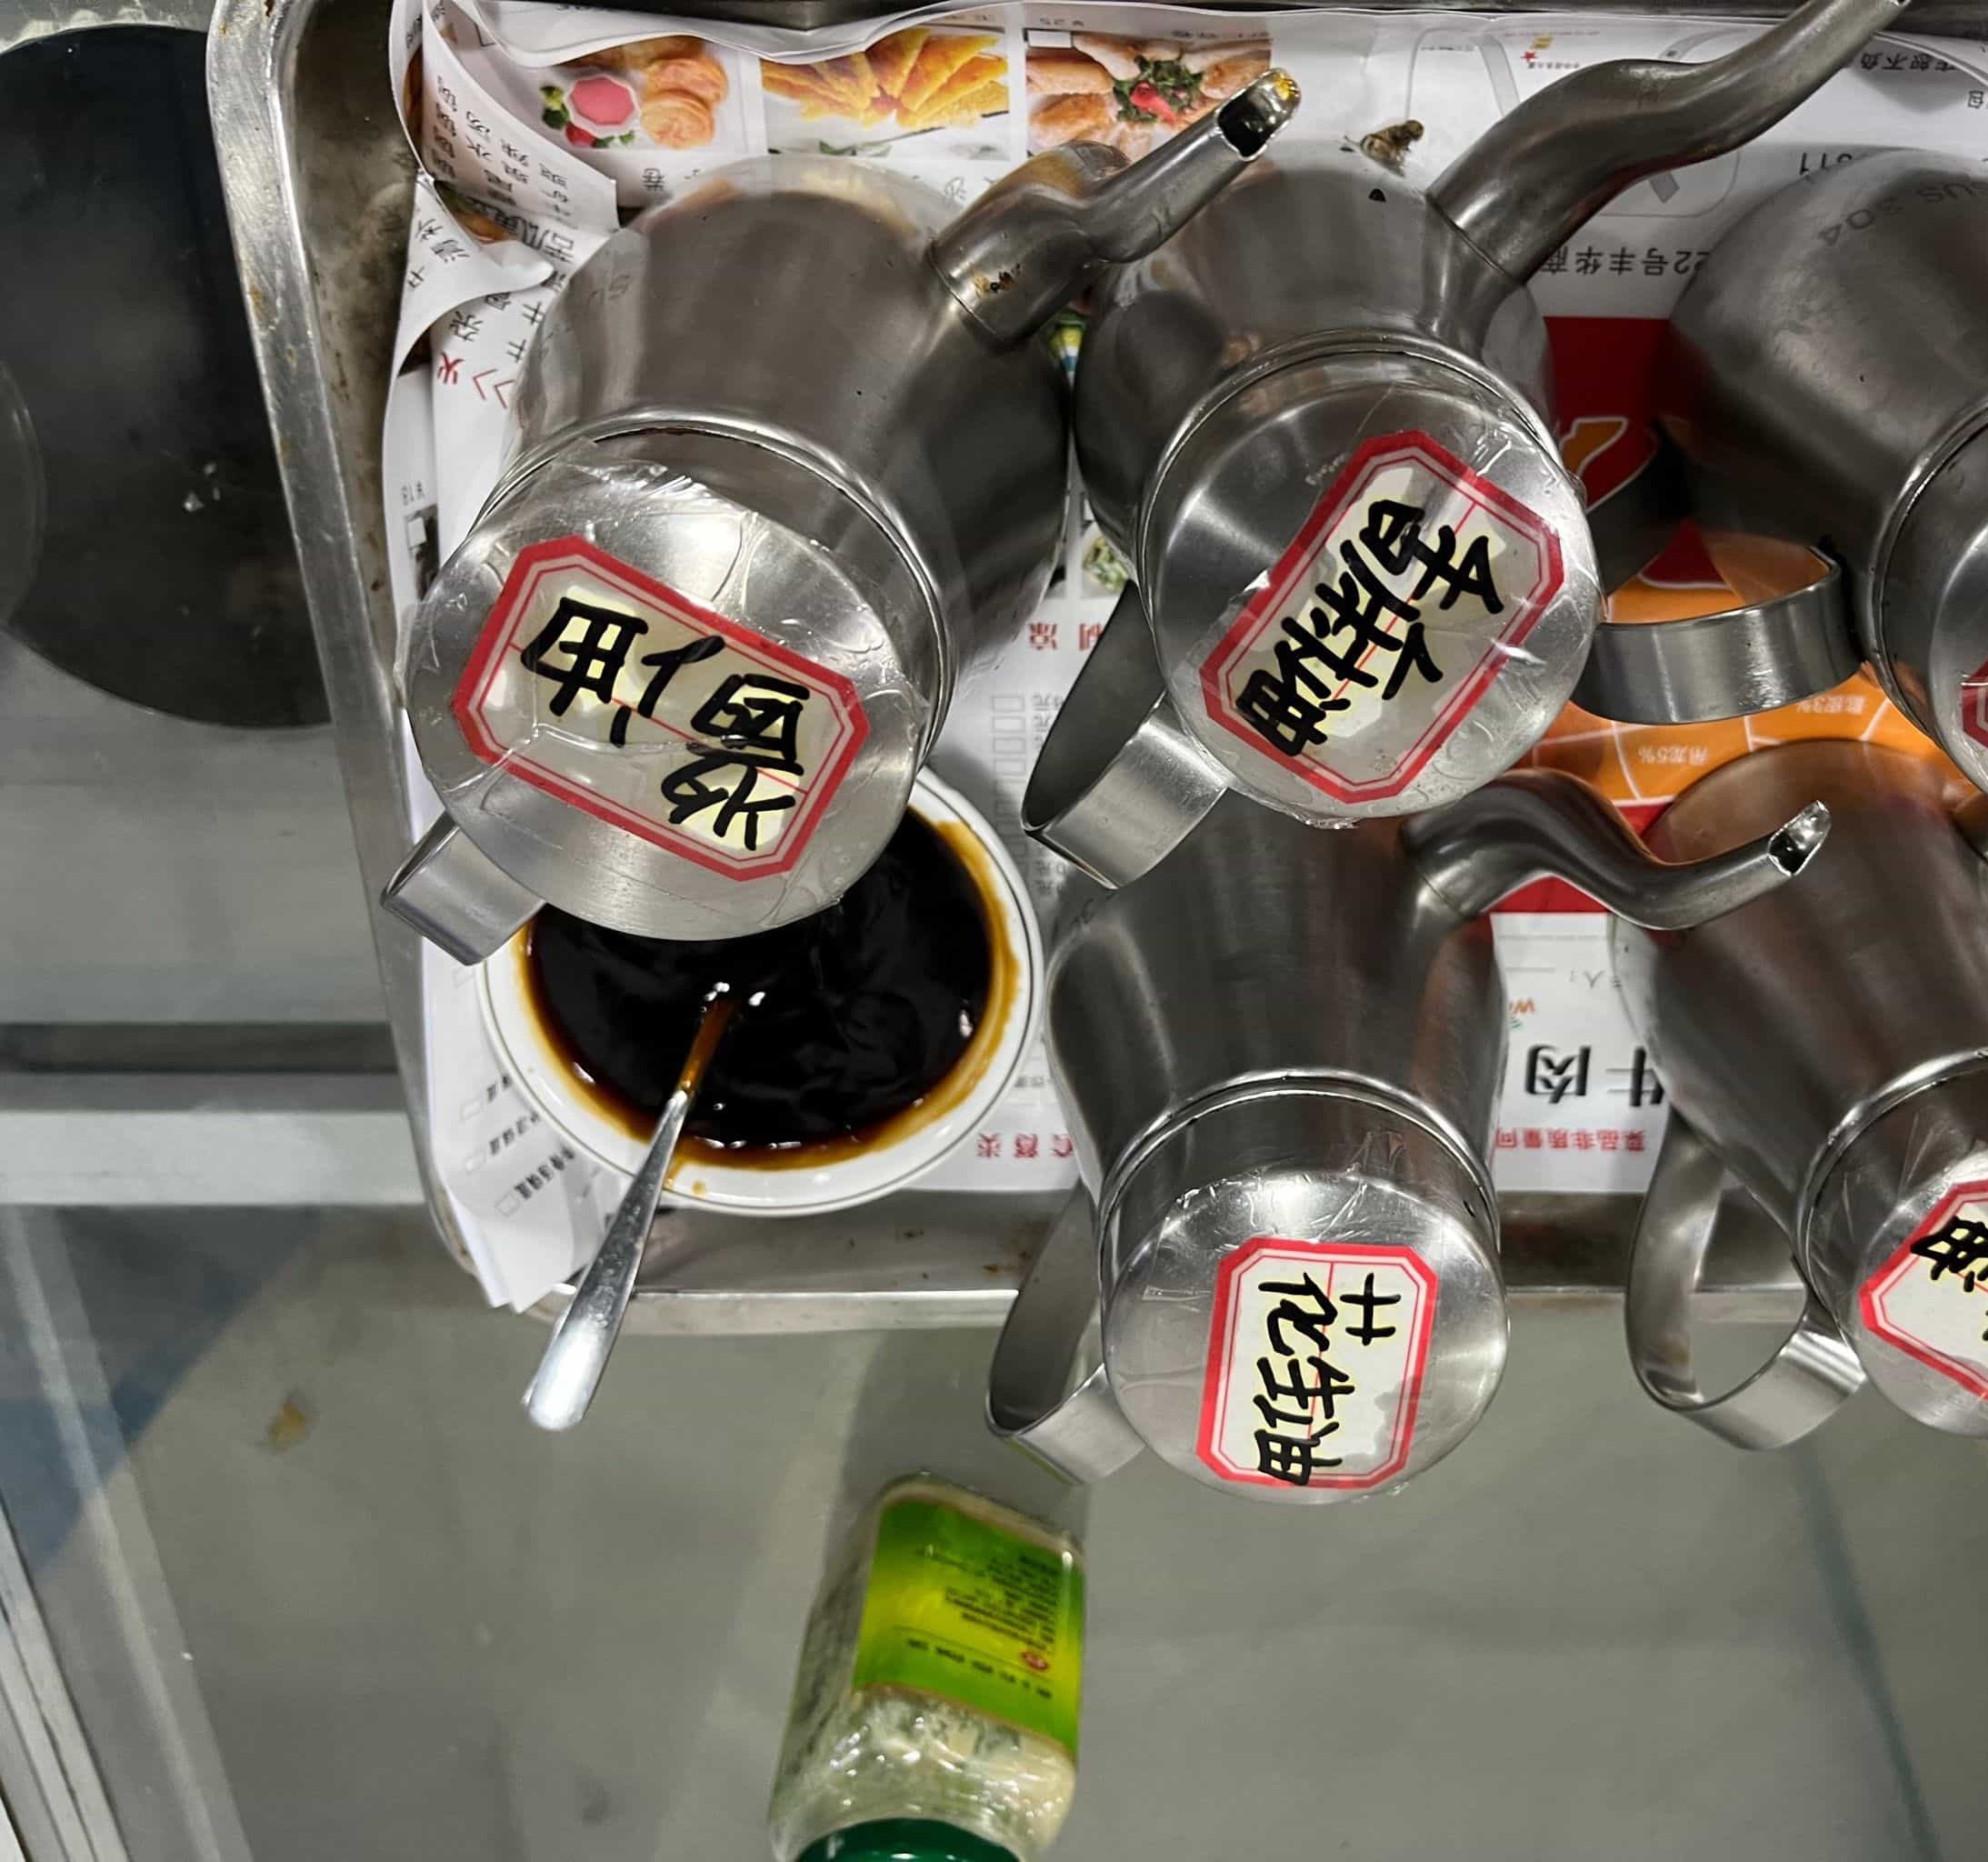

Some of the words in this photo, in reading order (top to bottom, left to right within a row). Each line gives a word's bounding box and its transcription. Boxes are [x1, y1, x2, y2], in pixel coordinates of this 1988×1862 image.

[520, 596, 810, 852] 酱油
[1235, 499, 1504, 756] 香麻油
[1523, 1045, 1664, 1107] 牛肉
[1254, 1272, 1402, 1486] 花生油
